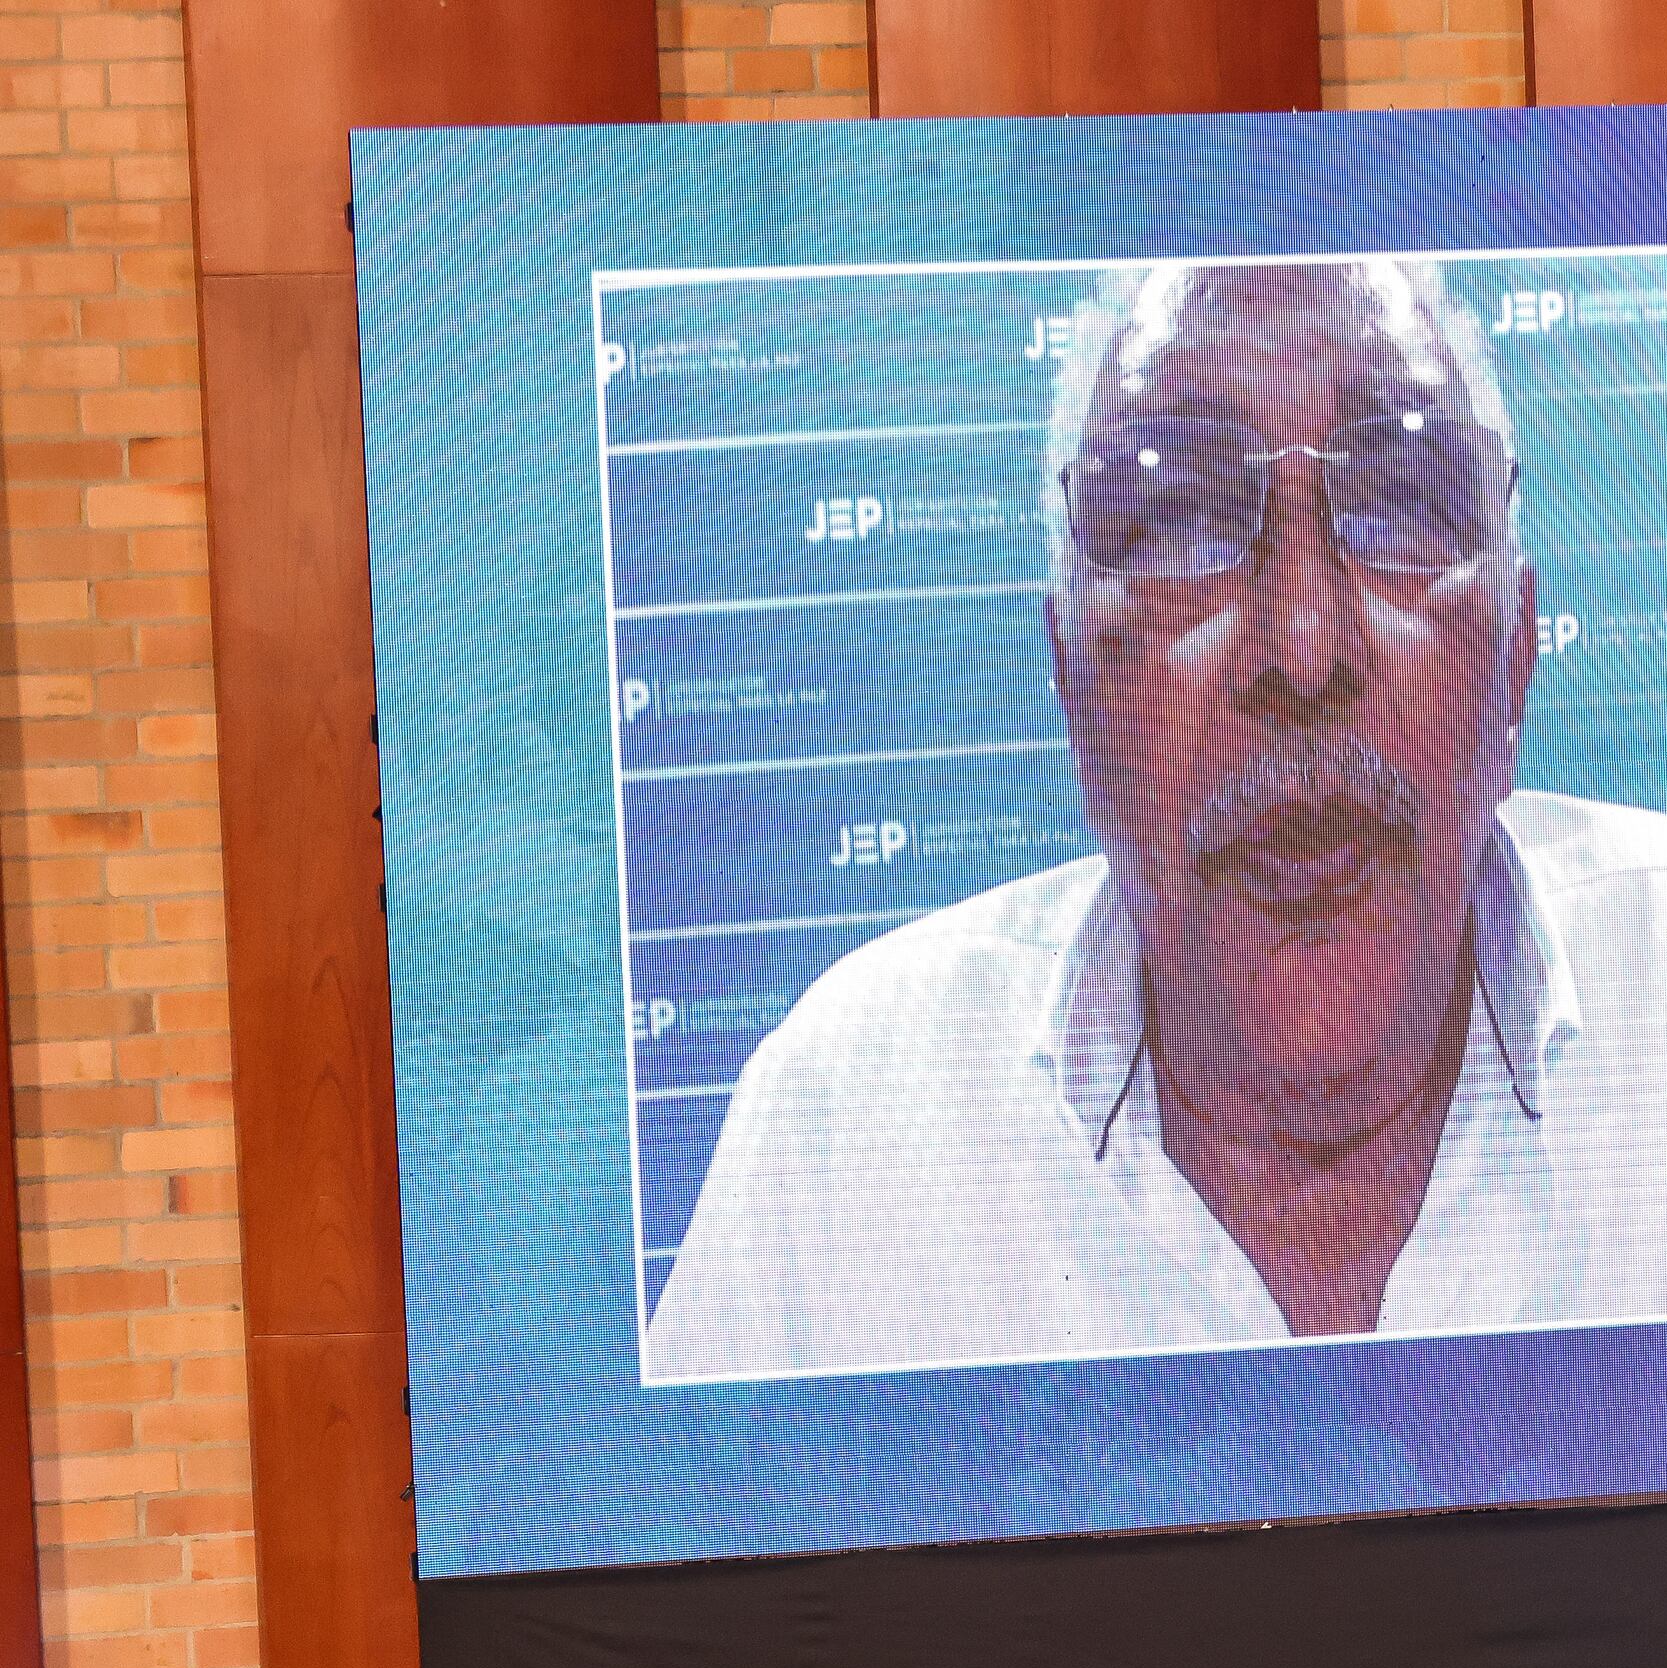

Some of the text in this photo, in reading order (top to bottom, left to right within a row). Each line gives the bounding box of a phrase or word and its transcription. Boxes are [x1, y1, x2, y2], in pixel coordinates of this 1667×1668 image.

[1494, 292, 1565, 334] JEP
[1025, 318, 1072, 359] JE
[805, 498, 882, 541] JEP
[1537, 615, 1579, 654] EP
[830, 821, 906, 866] JEP
[634, 999, 676, 1039] EP
